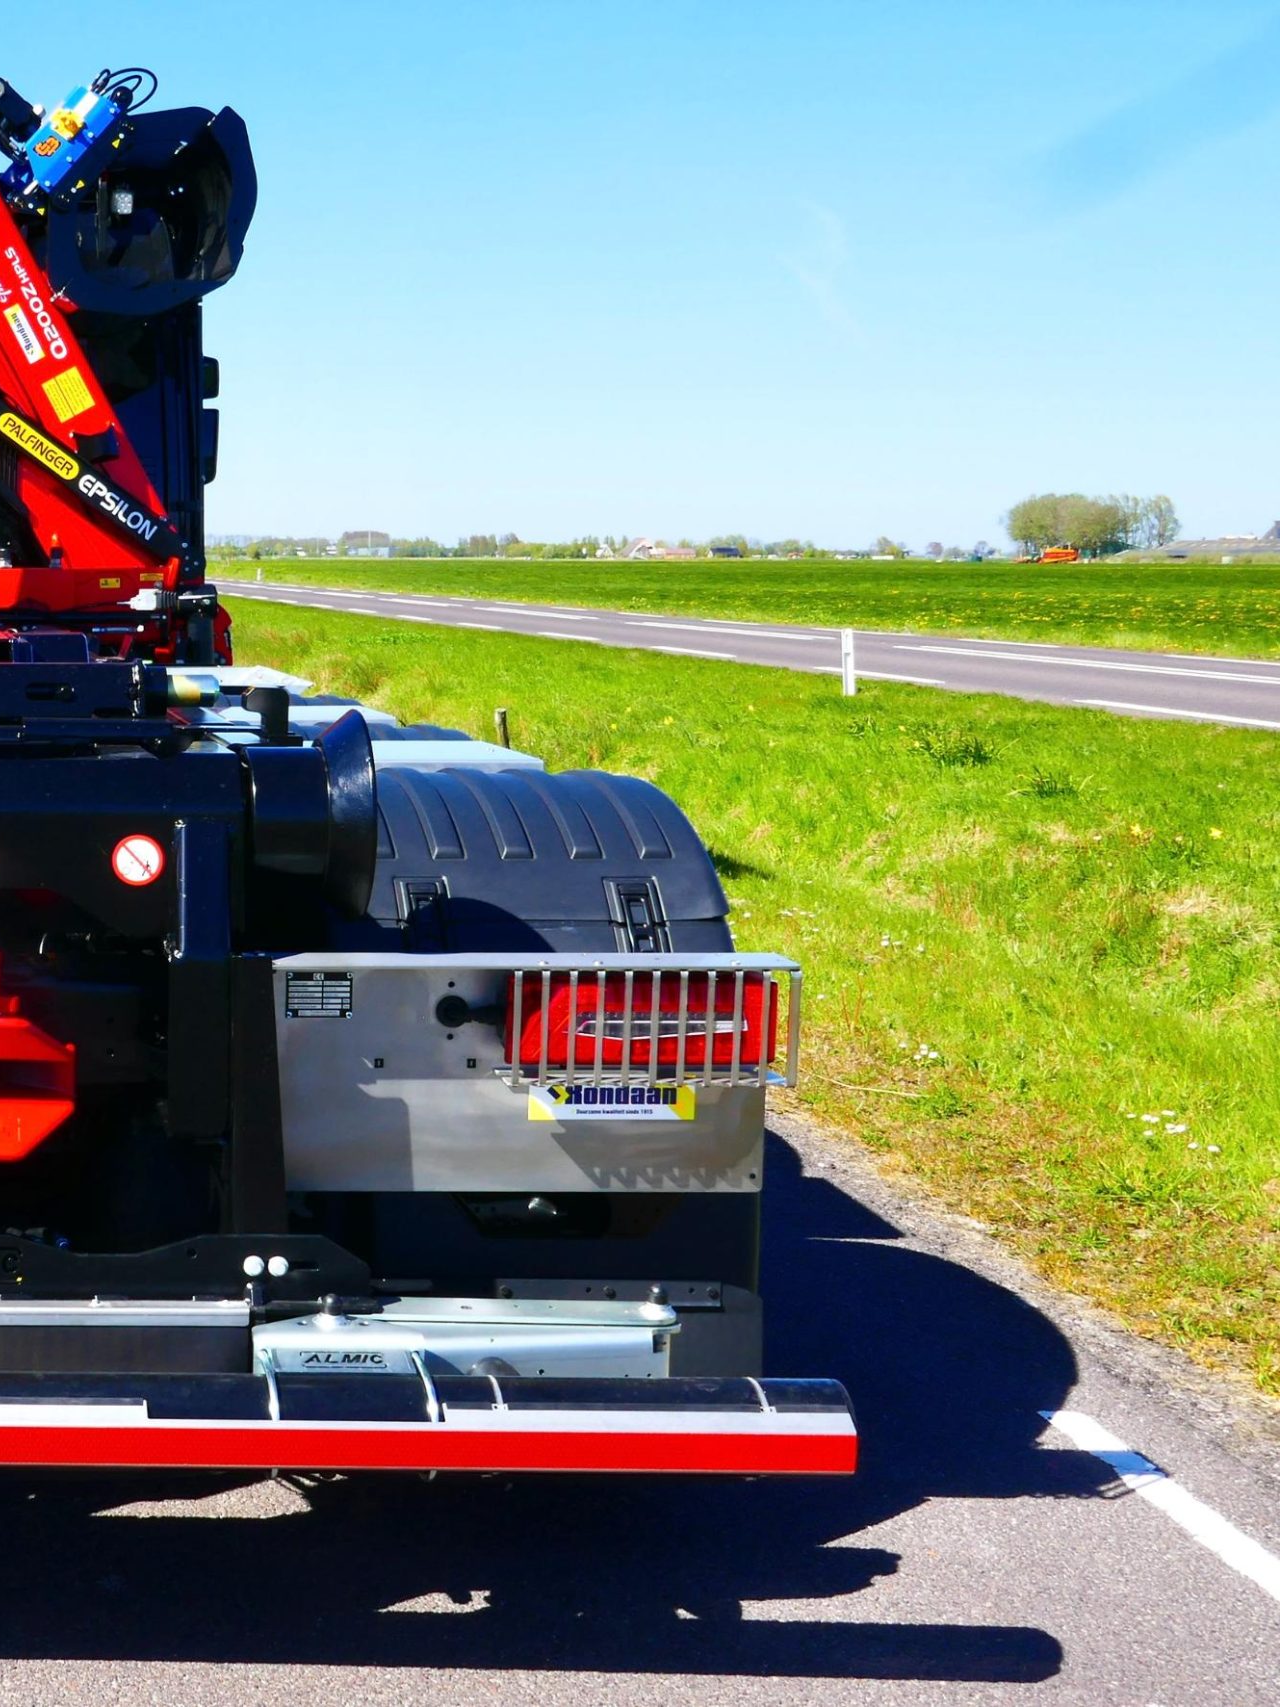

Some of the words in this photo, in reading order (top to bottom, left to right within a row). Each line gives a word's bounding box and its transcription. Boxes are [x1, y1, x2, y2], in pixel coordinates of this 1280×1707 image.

[4, 246, 30, 284] HPLS
[21, 286, 68, 360] Q200Z
[2, 417, 74, 476] PALFINGER
[78, 474, 158, 541] EPSILON
[304, 1354, 383, 1364] ALMIC
